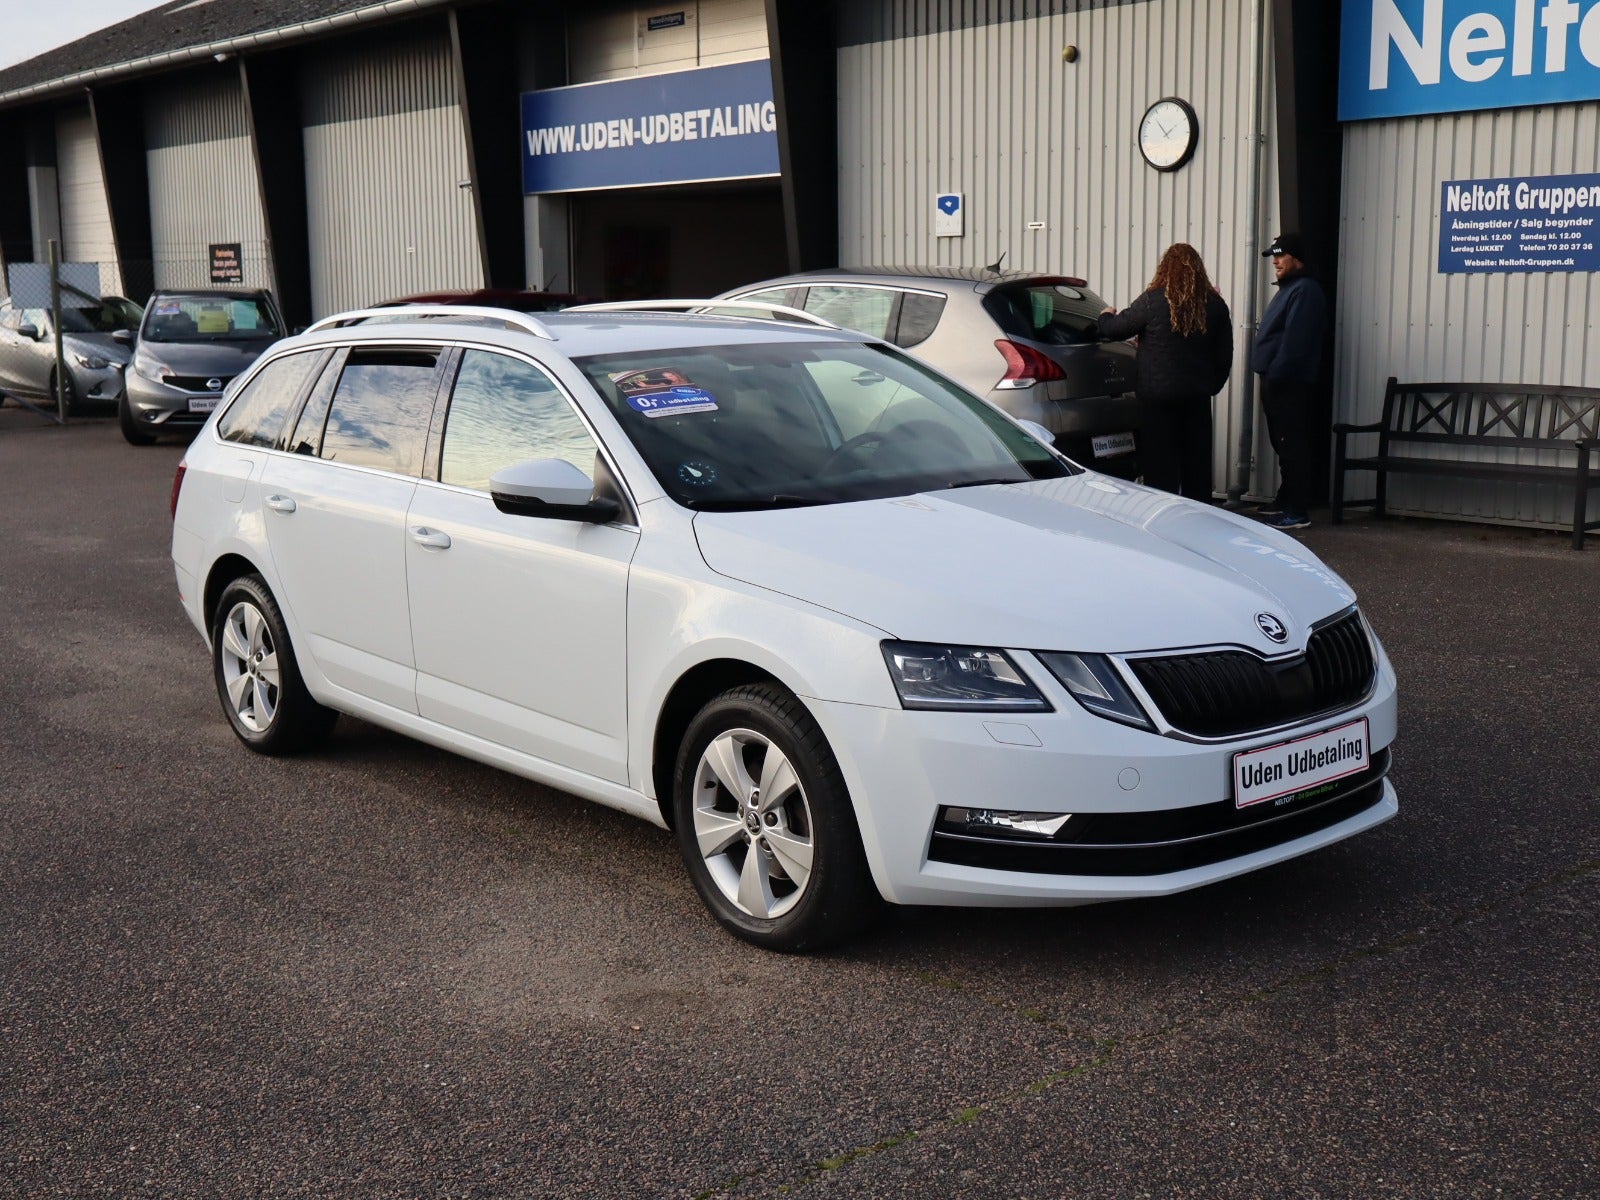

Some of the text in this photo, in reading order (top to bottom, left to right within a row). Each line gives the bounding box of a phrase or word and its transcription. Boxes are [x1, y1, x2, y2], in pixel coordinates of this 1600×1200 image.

[527, 100, 777, 156] WWW.UDEN-UDBETALING
[1447, 182, 1600, 214] Neltoft Gruppen
[1451, 217, 1594, 230] Åbningstider / Salg begynder
[1491, 233, 1512, 241] 12.00
[1520, 233, 1547, 241] Søndag
[1548, 232, 1558, 240] kl.
[1450, 244, 1505, 253] Lørdag LUKKET
[1547, 243, 1558, 251] 70
[1559, 243, 1570, 251] 20
[1464, 257, 1575, 267] Website: Neltoft-Gruppen.dk
[1241, 738, 1362, 789] Uden Udbetaling
